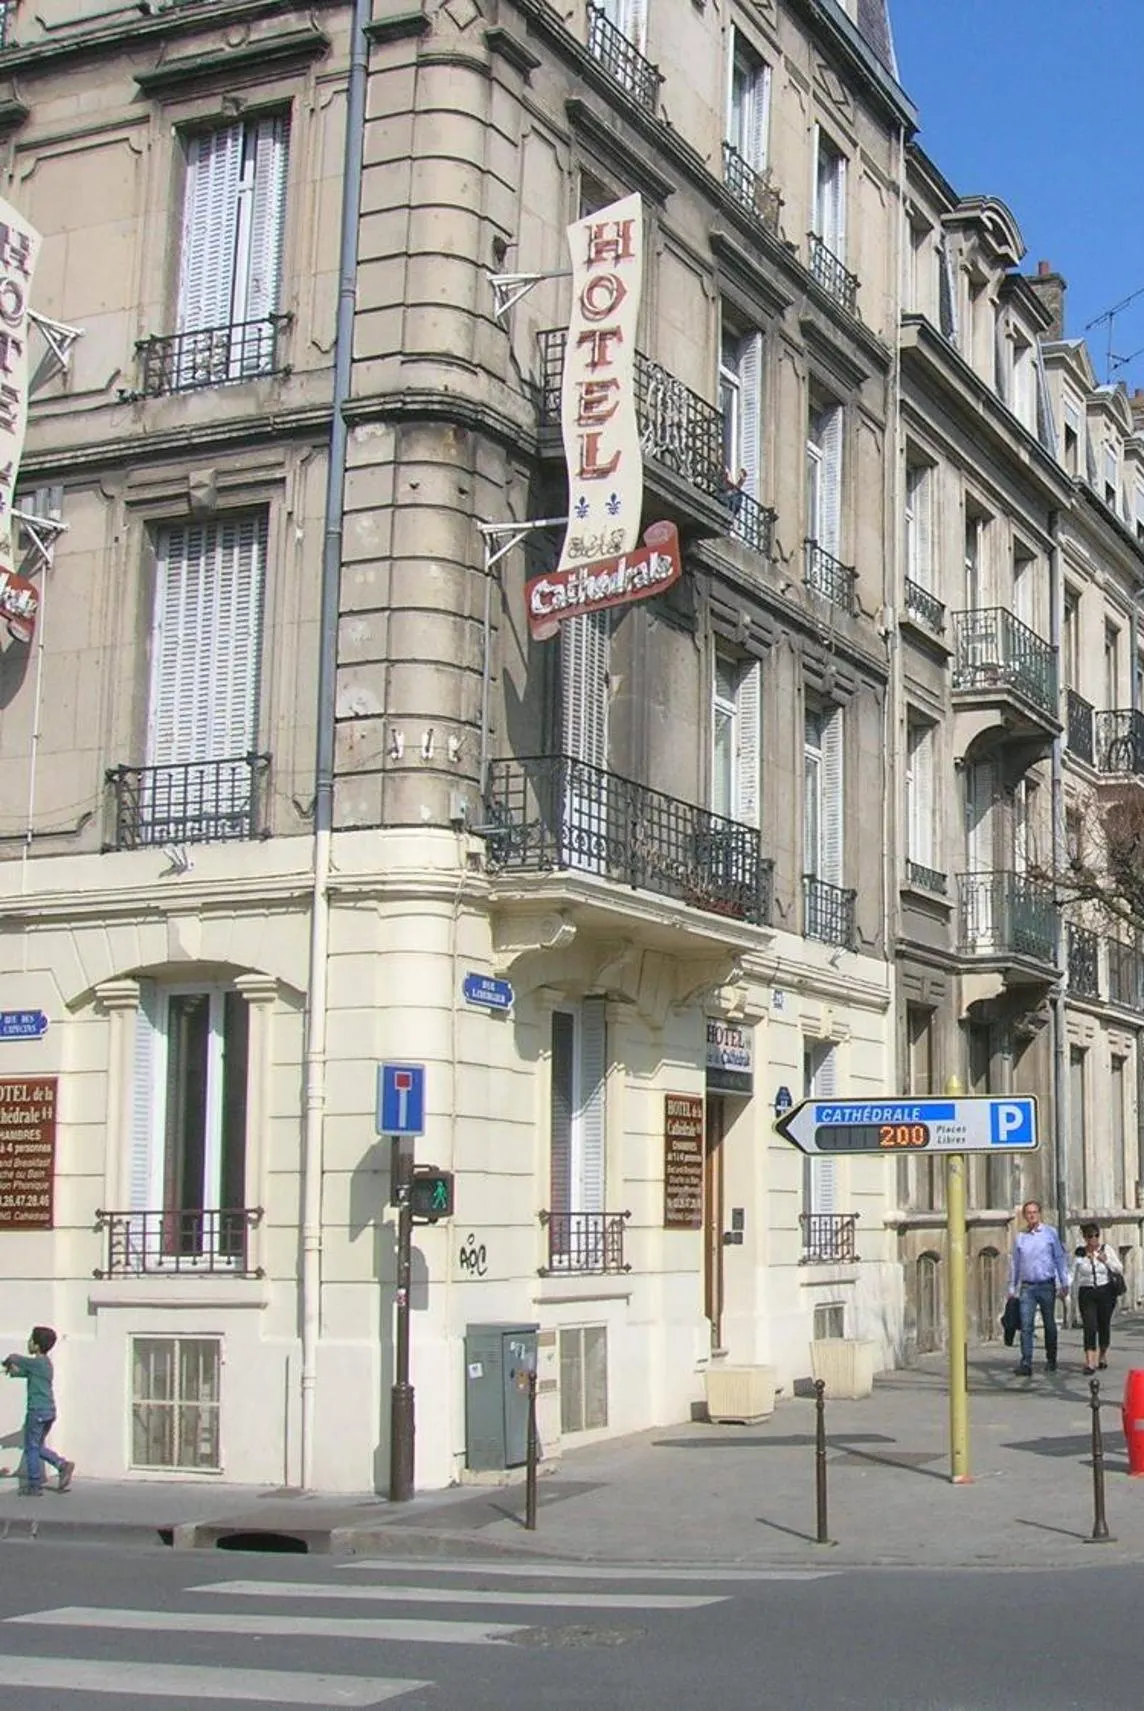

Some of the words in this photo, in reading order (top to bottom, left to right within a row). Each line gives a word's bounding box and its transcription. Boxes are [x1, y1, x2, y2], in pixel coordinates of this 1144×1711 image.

[575, 218, 636, 481] HOTEL
[706, 1022, 745, 1049] HOTEL
[822, 1106, 921, 1122] CATHÉDRALE
[998, 1105, 1024, 1142] P
[879, 1125, 925, 1147] 200
